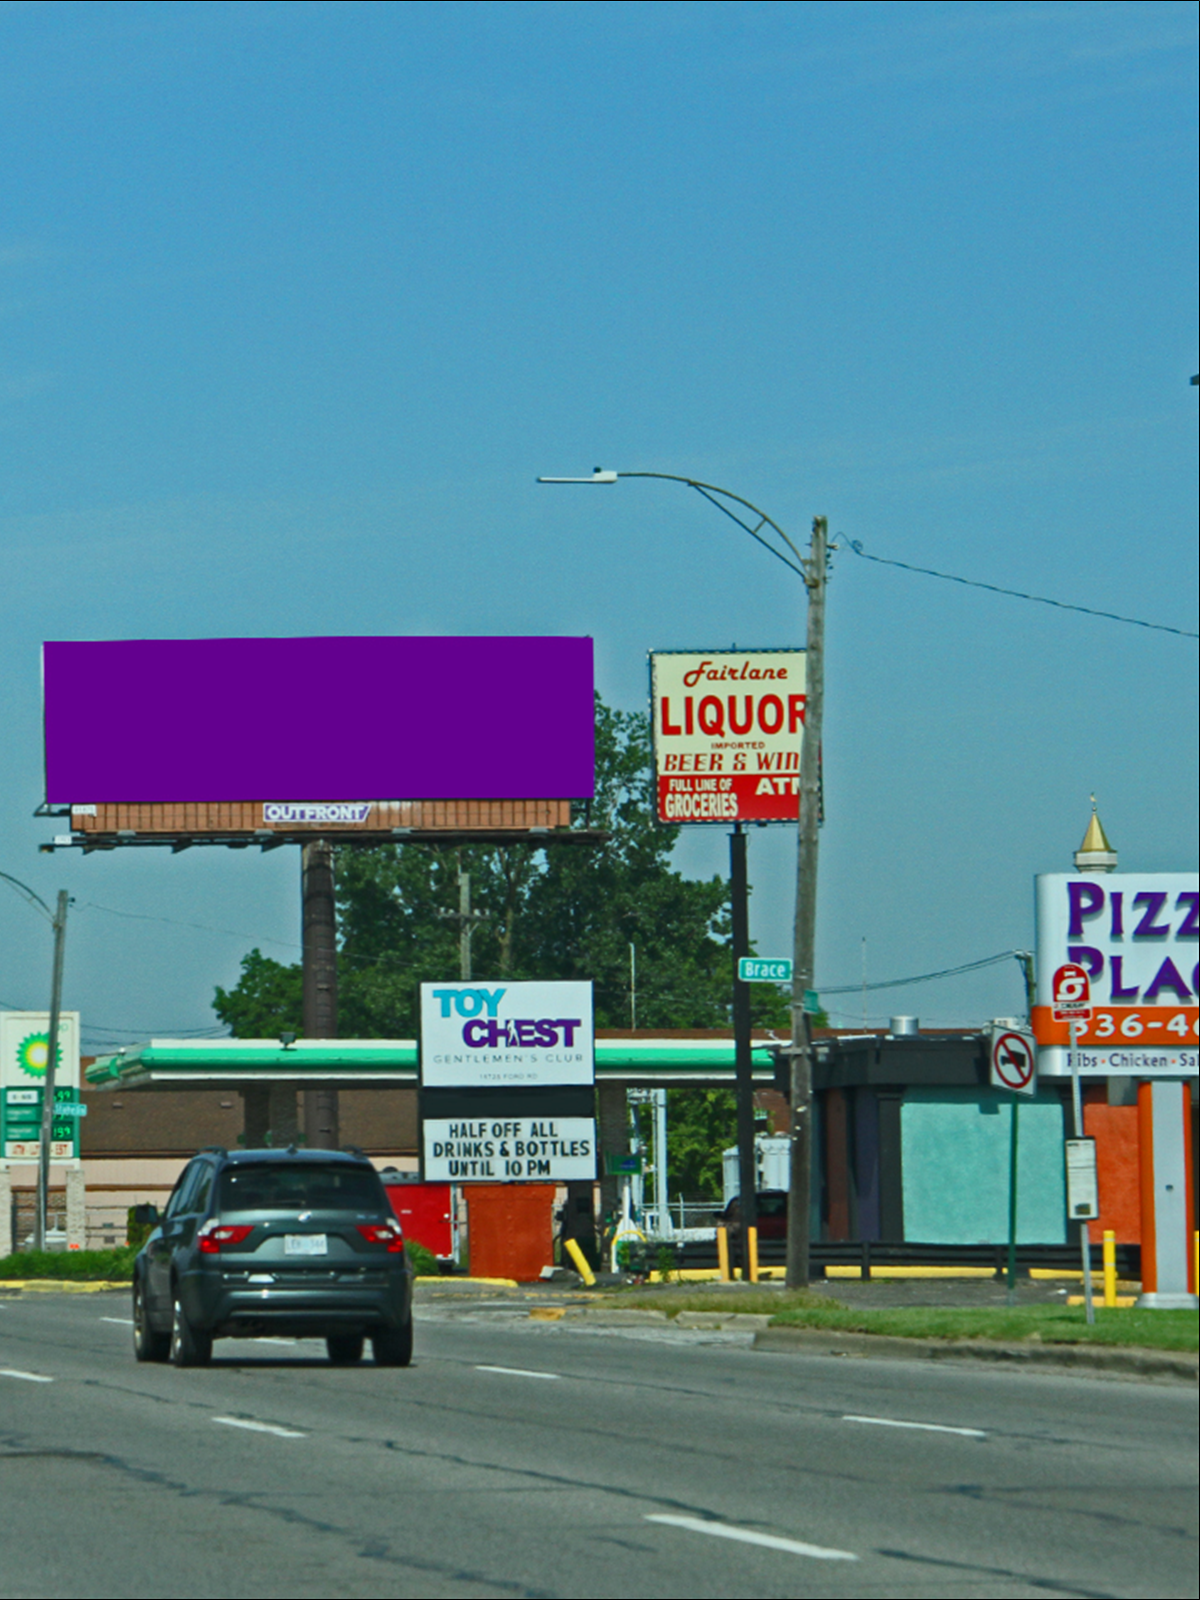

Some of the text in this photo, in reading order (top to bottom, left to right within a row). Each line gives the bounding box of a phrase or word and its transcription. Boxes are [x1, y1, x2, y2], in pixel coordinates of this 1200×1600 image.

[683, 661, 788, 687] Fairlane
[661, 694, 807, 738] LIQUOR
[711, 741, 765, 750] IMPORTED
[664, 752, 800, 771] BEER & WIN
[669, 778, 732, 791] FULL LINE OF
[267, 804, 365, 821] OUTFRONT
[665, 793, 738, 818] GROCERIES
[745, 961, 786, 977] Brace
[1067, 946, 1199, 999] PLA
[432, 988, 507, 1018] TOY
[462, 1019, 581, 1048] CHEST
[433, 1053, 583, 1064] GENTLEMEN'S CLUB
[1109, 1052, 1167, 1067] Chicken
[449, 1122, 558, 1138] HALF OFF ALL
[433, 1140, 590, 1158] DRINKS & BOTTLES
[449, 1159, 550, 1176] UNTIL 10 PM
